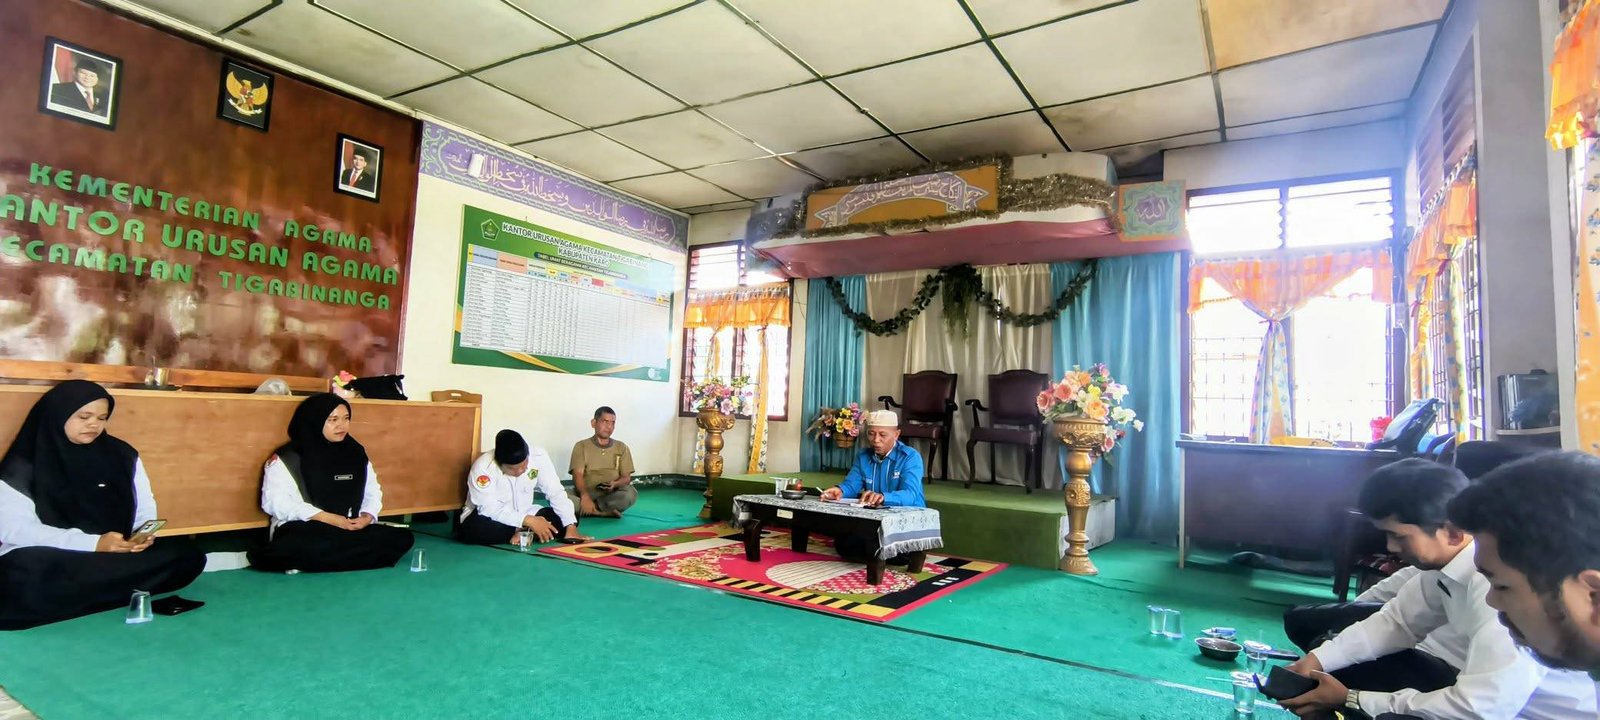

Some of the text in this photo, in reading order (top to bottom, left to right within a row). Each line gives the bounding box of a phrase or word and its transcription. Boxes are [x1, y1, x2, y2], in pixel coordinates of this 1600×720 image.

[0, 194, 398, 285] ANTOR URUSAN AGAMA
[29, 161, 372, 253] KEMENTERIAN AGAMA
[502, 222, 533, 238] KANTOR
[533, 231, 560, 245] URUSAN
[560, 238, 583, 251] AGAMA
[1, 235, 391, 310] ECAMATAN TIGABINANGA
[558, 247, 594, 262] KABUPATEN
